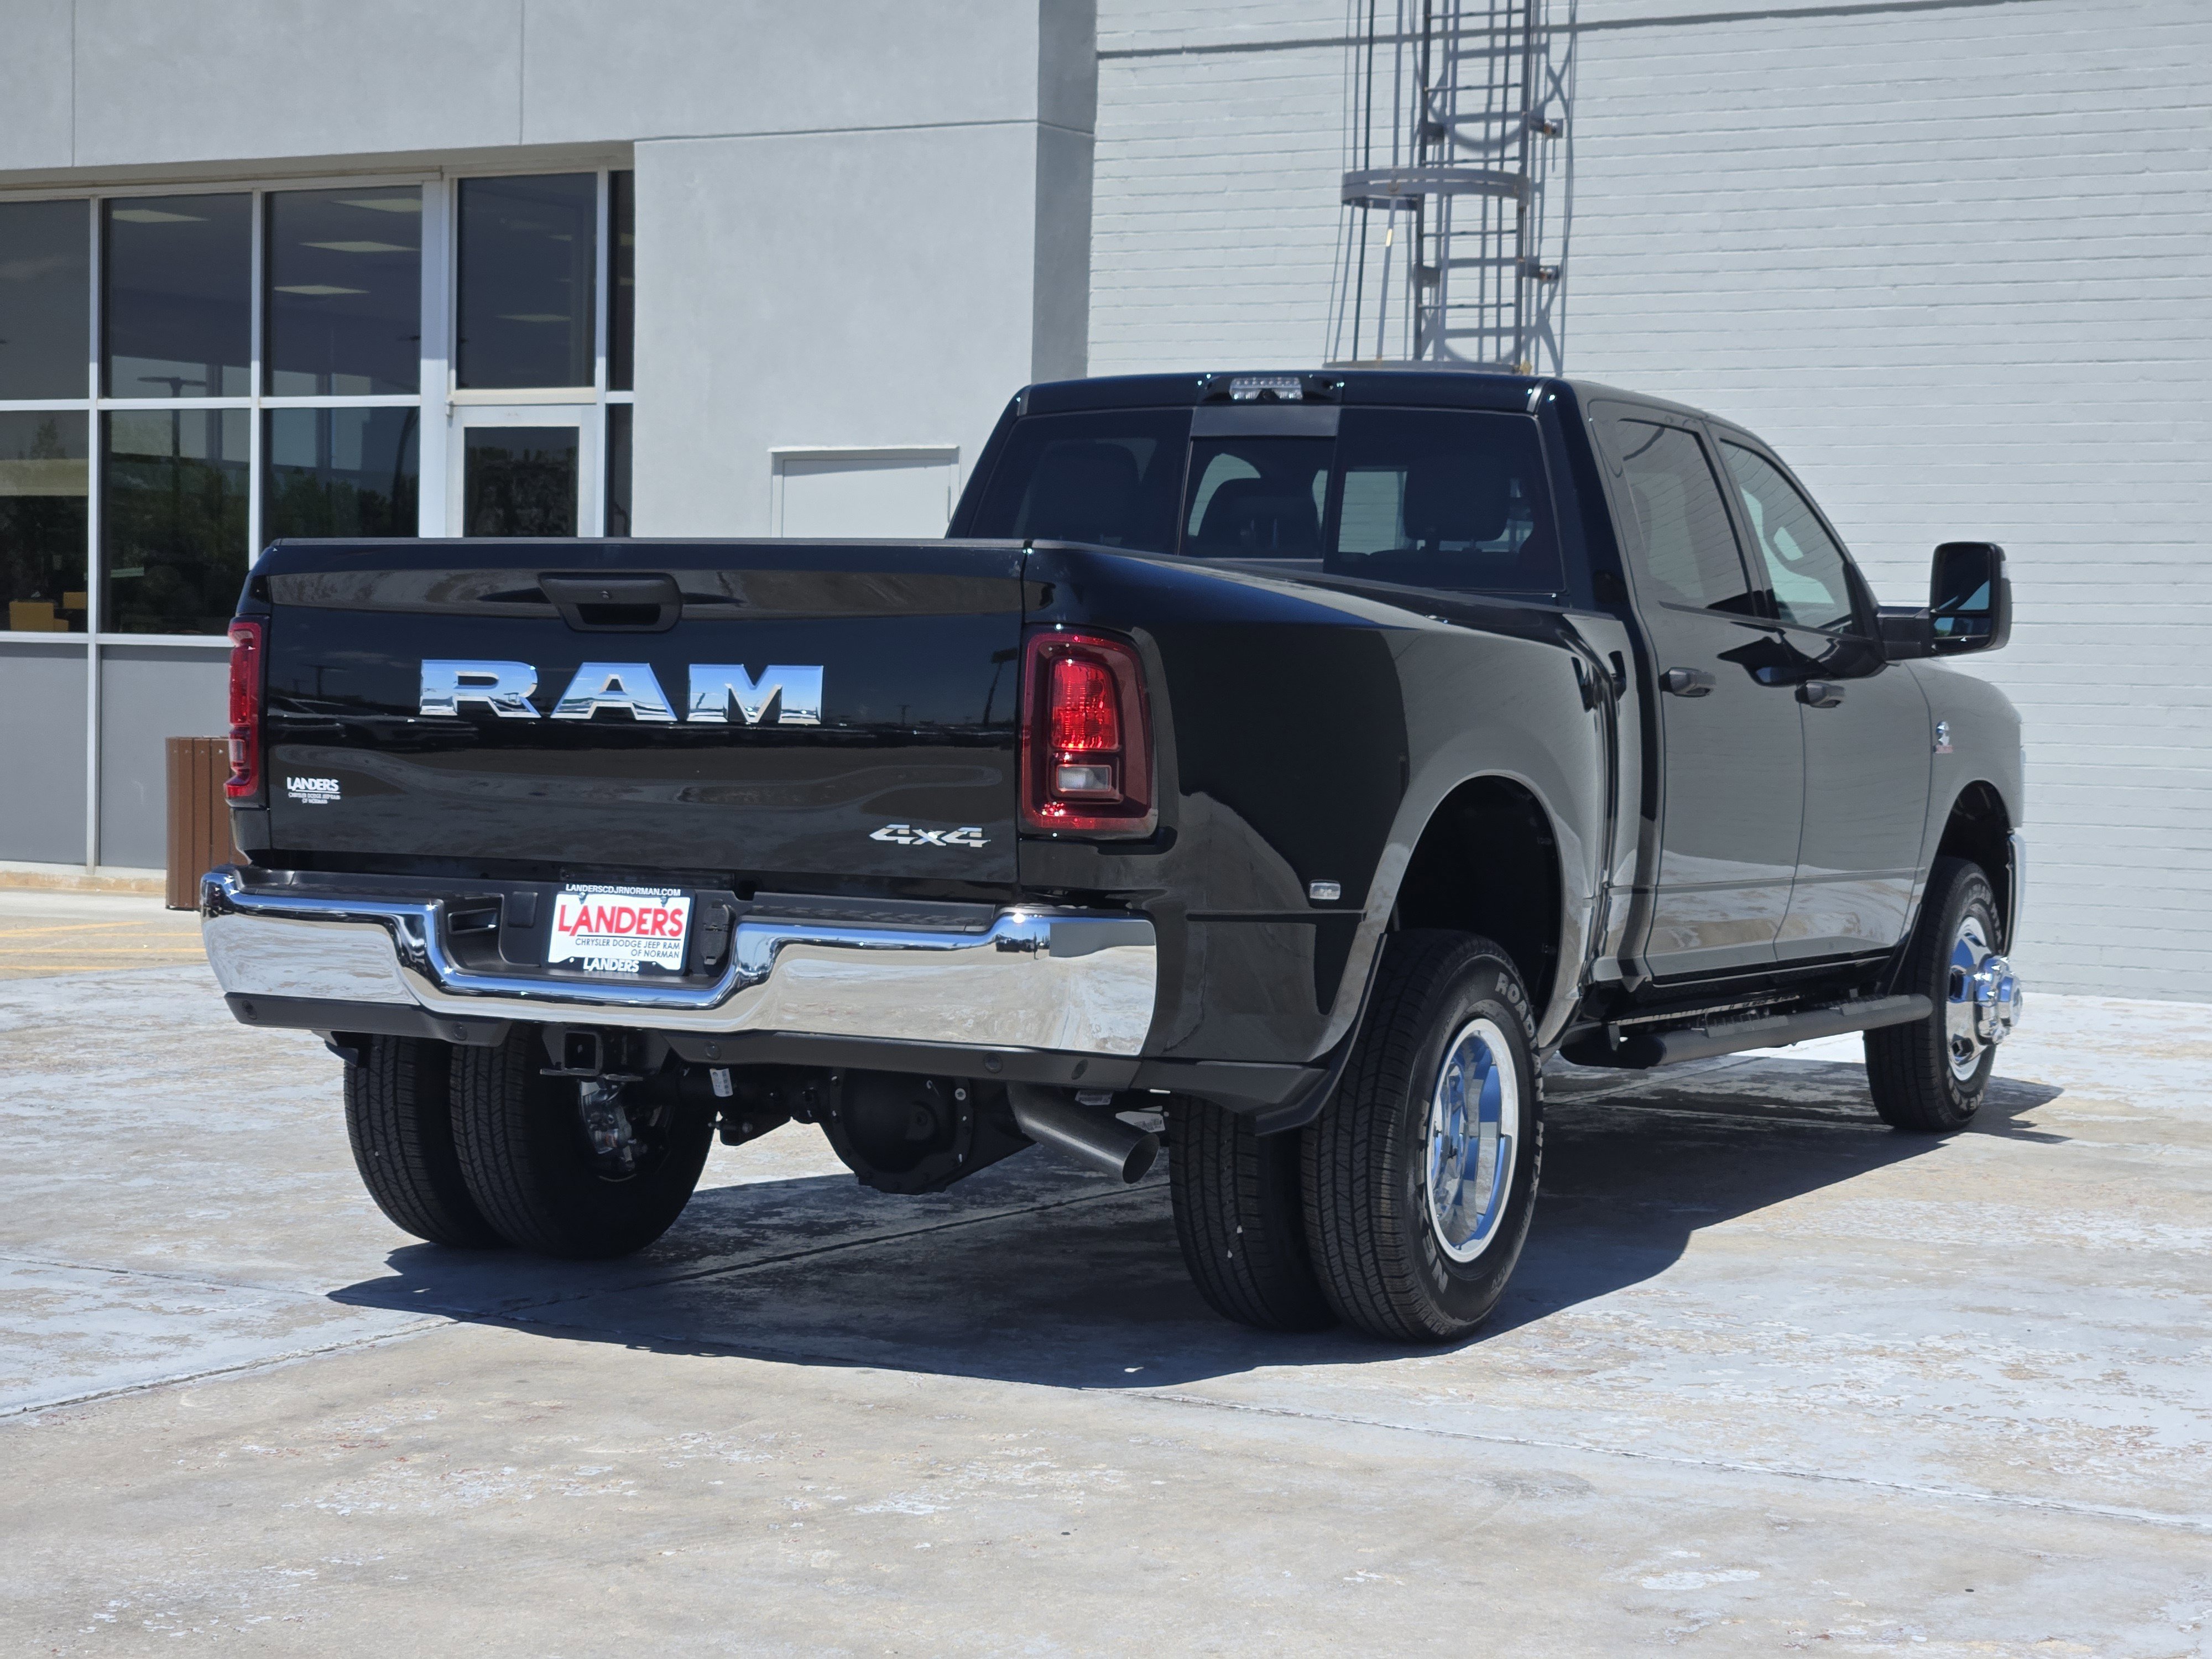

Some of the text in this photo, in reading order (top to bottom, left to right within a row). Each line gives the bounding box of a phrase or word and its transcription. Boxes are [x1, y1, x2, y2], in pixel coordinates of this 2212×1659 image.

[419, 659, 824, 724] RAM
[287, 777, 339, 792] LANDERS
[565, 884, 681, 896] LANDERSCDJRNORMAN.COM
[558, 904, 684, 937] LANDERS
[575, 938, 611, 947] CHRYSLER
[612, 939, 642, 948] DODGE
[644, 941, 661, 949] JEEP
[630, 948, 680, 958] OF NORMAN
[583, 957, 639, 973] LANDERS
